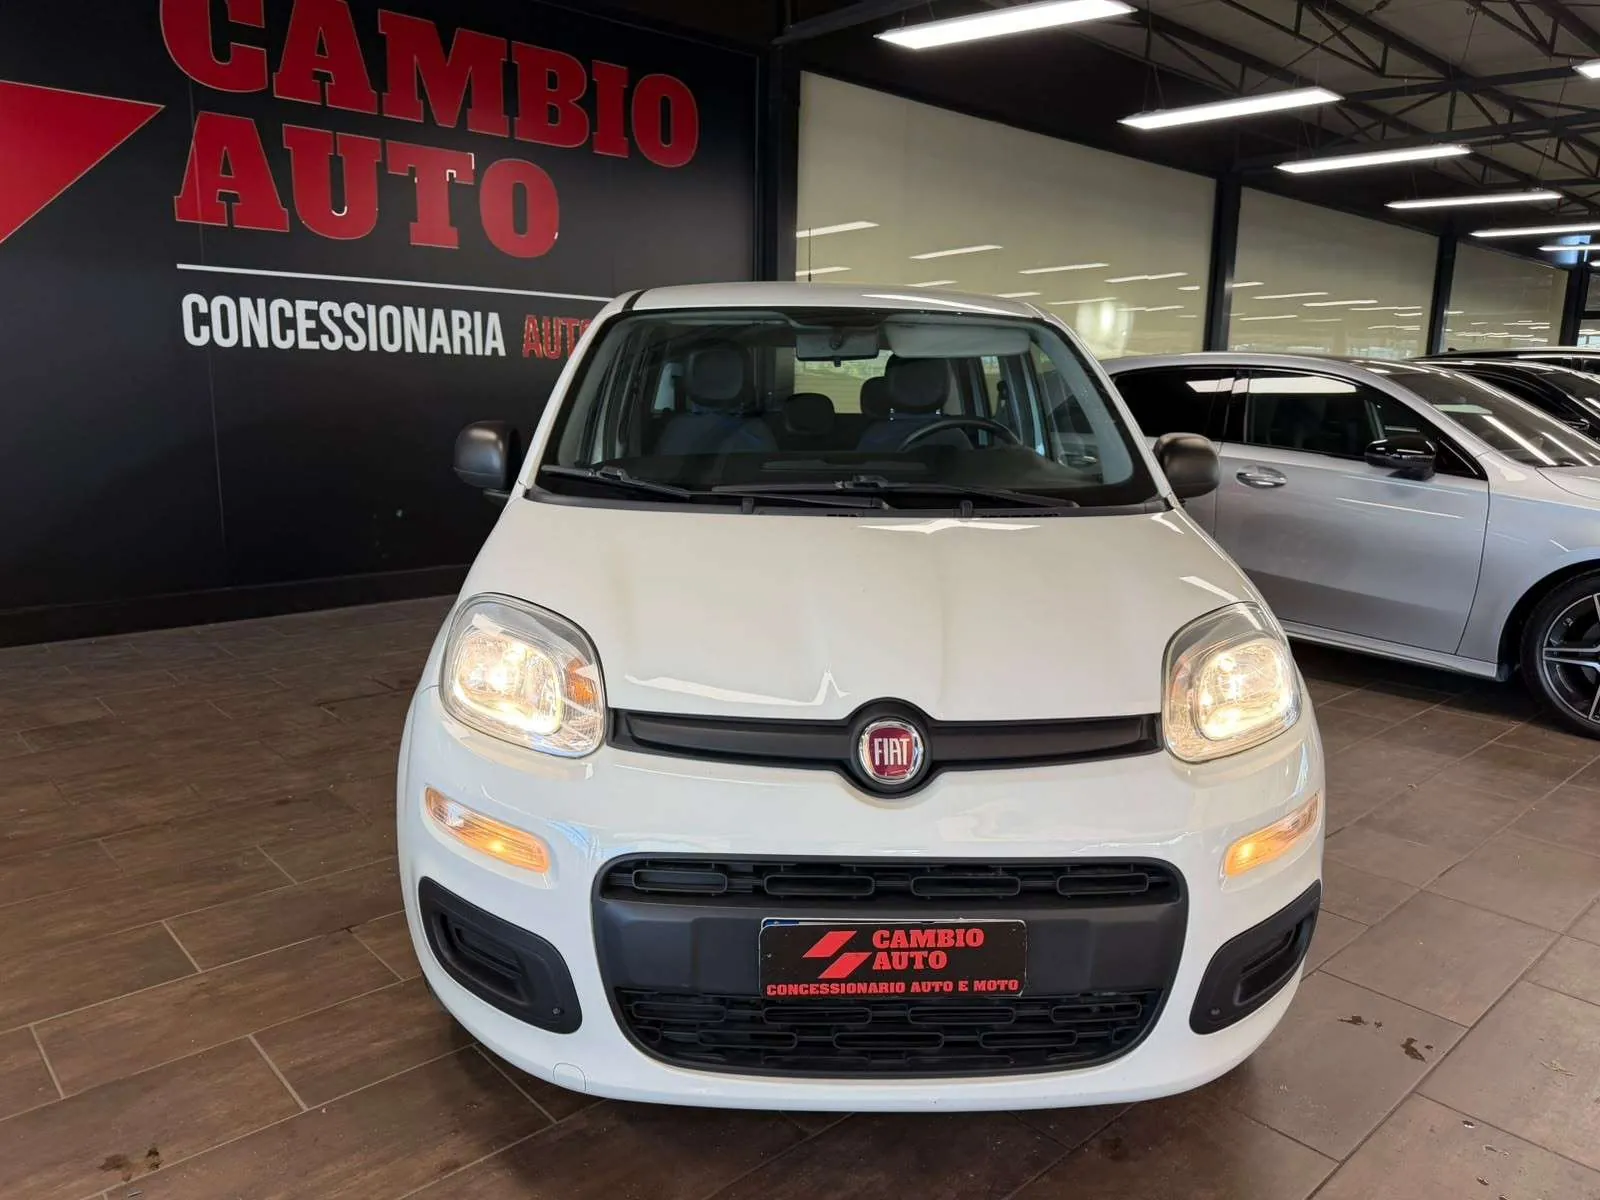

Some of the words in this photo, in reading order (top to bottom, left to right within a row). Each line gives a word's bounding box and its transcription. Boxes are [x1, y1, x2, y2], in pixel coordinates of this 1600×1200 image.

[160, 0, 699, 168] CAMBIO
[174, 110, 560, 259] AUTO
[182, 293, 506, 357] CONCESSIONARIA
[874, 737, 910, 766] FIAT
[872, 928, 984, 949] CAMBIO
[872, 951, 948, 970] AUTO
[766, 983, 905, 996] CONCESSIONARIO
[910, 981, 953, 993] AUTO
[958, 981, 968, 992] E
[973, 979, 1019, 992] MOTO
